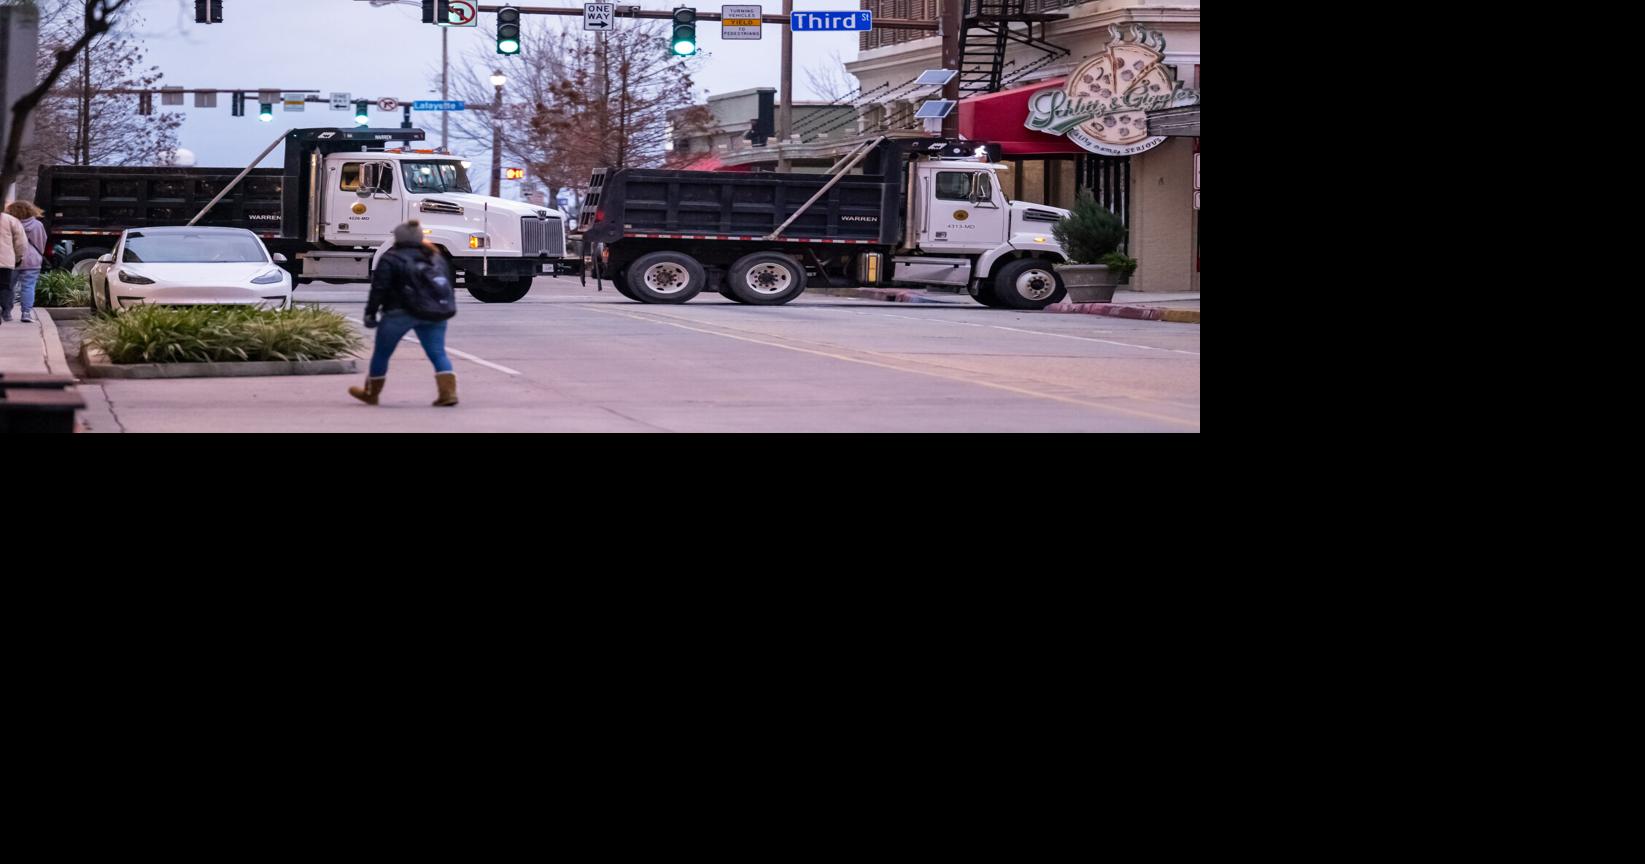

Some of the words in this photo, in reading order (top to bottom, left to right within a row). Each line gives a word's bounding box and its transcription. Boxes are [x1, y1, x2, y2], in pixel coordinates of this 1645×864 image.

[794, 14, 856, 28] Third
[414, 101, 456, 110] Lafayette
[1109, 98, 1120, 111] &
